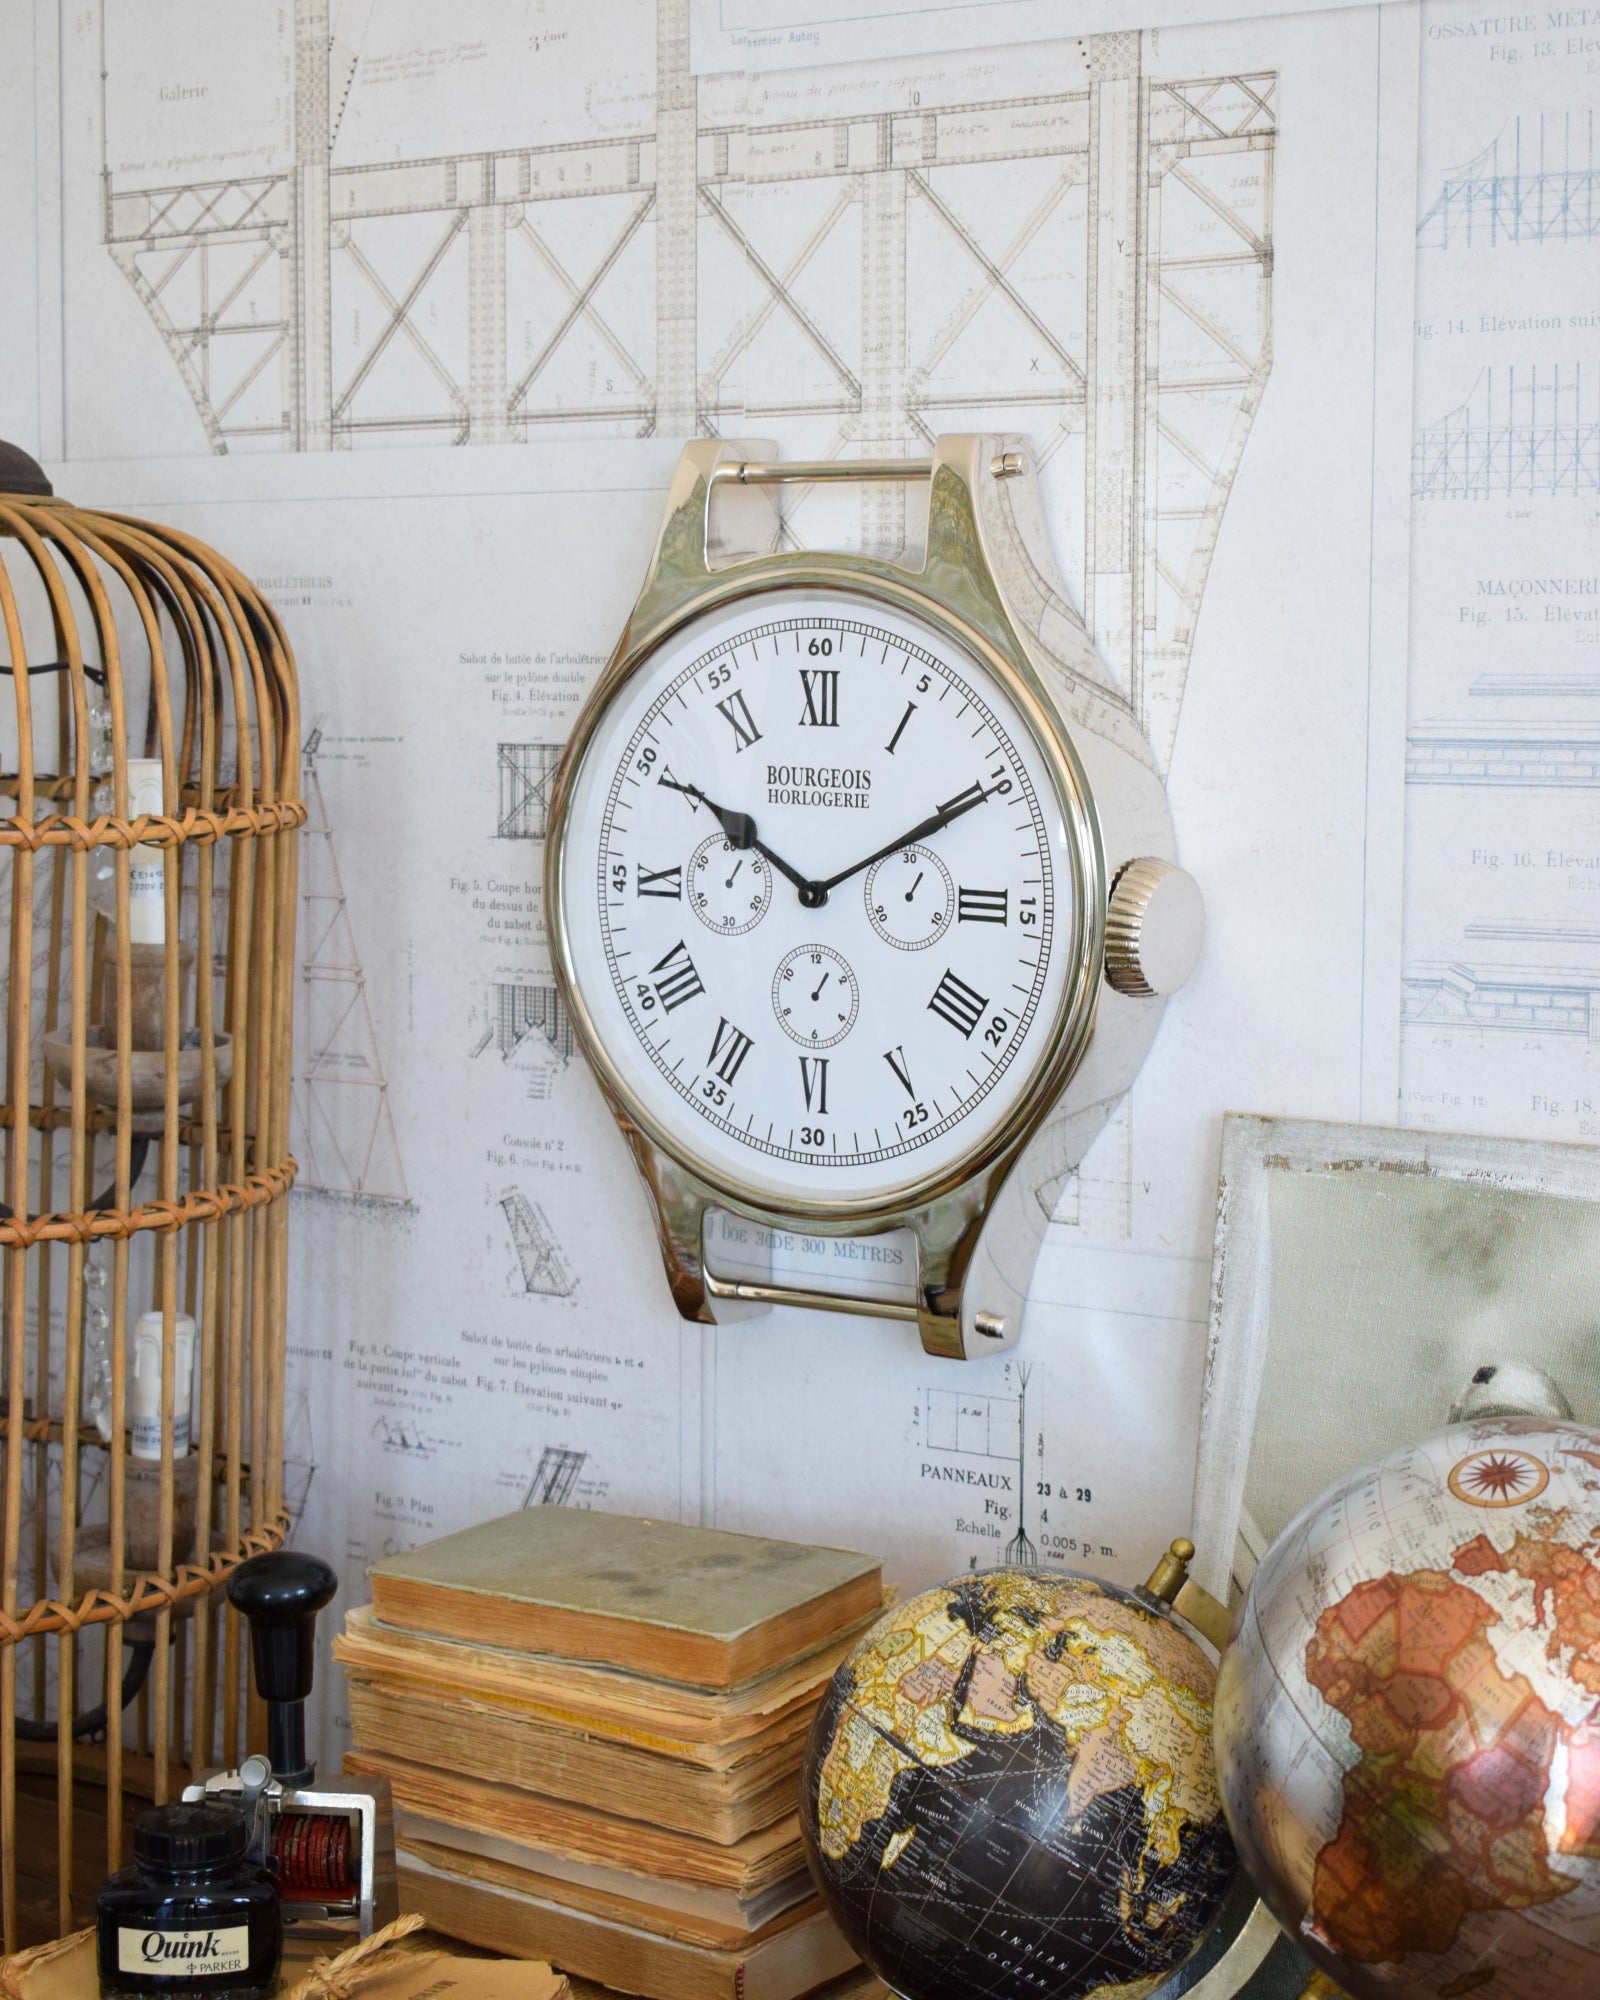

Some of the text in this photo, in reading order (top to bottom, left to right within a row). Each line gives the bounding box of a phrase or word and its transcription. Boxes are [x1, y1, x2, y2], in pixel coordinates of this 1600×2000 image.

[1428, 15, 1537, 41] OSSATURE
[1490, 44, 1523, 65] Fig.
[159, 83, 209, 102] Galerie
[1117, 239, 1124, 253] Y
[1030, 357, 1038, 371] X
[1458, 606, 1492, 627] Fig.
[808, 638, 833, 656] 60
[459, 652, 488, 665] Sabot
[491, 652, 501, 665] de
[535, 652, 547, 665] de
[485, 674, 501, 683] sur
[504, 671, 513, 683] le
[552, 671, 586, 683] double
[708, 664, 731, 689] 55
[916, 674, 932, 693] 5
[491, 689, 510, 705] Fig.
[529, 687, 580, 702] Élévation
[798, 669, 840, 727] XII
[715, 688, 764, 754] XI
[884, 700, 918, 755] I
[636, 747, 657, 776] 50
[766, 765, 871, 790] BOURGEOIS
[990, 765, 1013, 795] 10
[767, 789, 870, 809] HORLOGERIE
[697, 855, 709, 871] 50
[750, 859, 762, 874] 10
[903, 852, 917, 864] 30
[1472, 849, 1504, 871] Fig.
[450, 878, 470, 895] Fig.
[487, 879, 521, 897] Coupe
[612, 864, 627, 893] 45
[637, 862, 682, 901] IX
[472, 899, 486, 910] du
[489, 899, 523, 913] dessus
[696, 892, 708, 908] 40
[750, 895, 762, 911] 20
[958, 885, 1008, 927] III
[722, 916, 736, 927] 30
[874, 905, 888, 922] 20
[931, 911, 943, 926] 10
[1019, 897, 1036, 925] 15
[487, 917, 532, 931] du sabot
[810, 953, 822, 964] 12
[648, 939, 706, 1015] VIII
[783, 968, 794, 982] 10
[838, 975, 848, 985] 2
[636, 983, 656, 1011] 40
[811, 1029, 818, 1039] 6
[984, 1016, 1007, 1048] 20
[706, 1016, 755, 1087] VII
[883, 1045, 916, 1102] V
[702, 1080, 728, 1106] 35
[798, 1056, 830, 1115] VI
[903, 1102, 929, 1129] 25
[1531, 1095, 1564, 1118] Fig.
[503, 1134, 541, 1149] Console
[557, 1140, 564, 1151] 2
[800, 1127, 825, 1146] 30
[486, 1150, 507, 1165] Fig.
[802, 1239, 825, 1255] 300
[833, 1237, 904, 1265] MÈTRES
[460, 1330, 488, 1345] Sabot
[491, 1334, 503, 1348] de
[350, 1340, 369, 1356] Fig.
[383, 1345, 415, 1363] Coupe
[418, 1351, 461, 1369] verticale
[343, 1359, 467, 1387] de la partie du sabot
[493, 1356, 509, 1367] sur
[513, 1355, 527, 1369] les
[570, 1366, 609, 1383] simples
[357, 1377, 394, 1393] suivant
[476, 1375, 496, 1392] Fig.
[514, 1379, 563, 1401] Élévation
[567, 1393, 608, 1408] suivant
[921, 1463, 1092, 1502] PANNEAUX 23 à 29
[410, 1496, 434, 1515] Plan
[984, 1499, 1048, 1523] Fig. 4
[955, 1518, 1002, 1539] Échelle
[1040, 1534, 1077, 1551] 0.005
[1082, 1542, 1096, 1558] p.
[1100, 1545, 1118, 1558] m.
[141, 1931, 222, 1963] Quink
[1000, 1930, 1069, 1971] INDIAN
[200, 1959, 242, 1973] PARKER
[988, 1952, 1048, 1987] OCEAN
